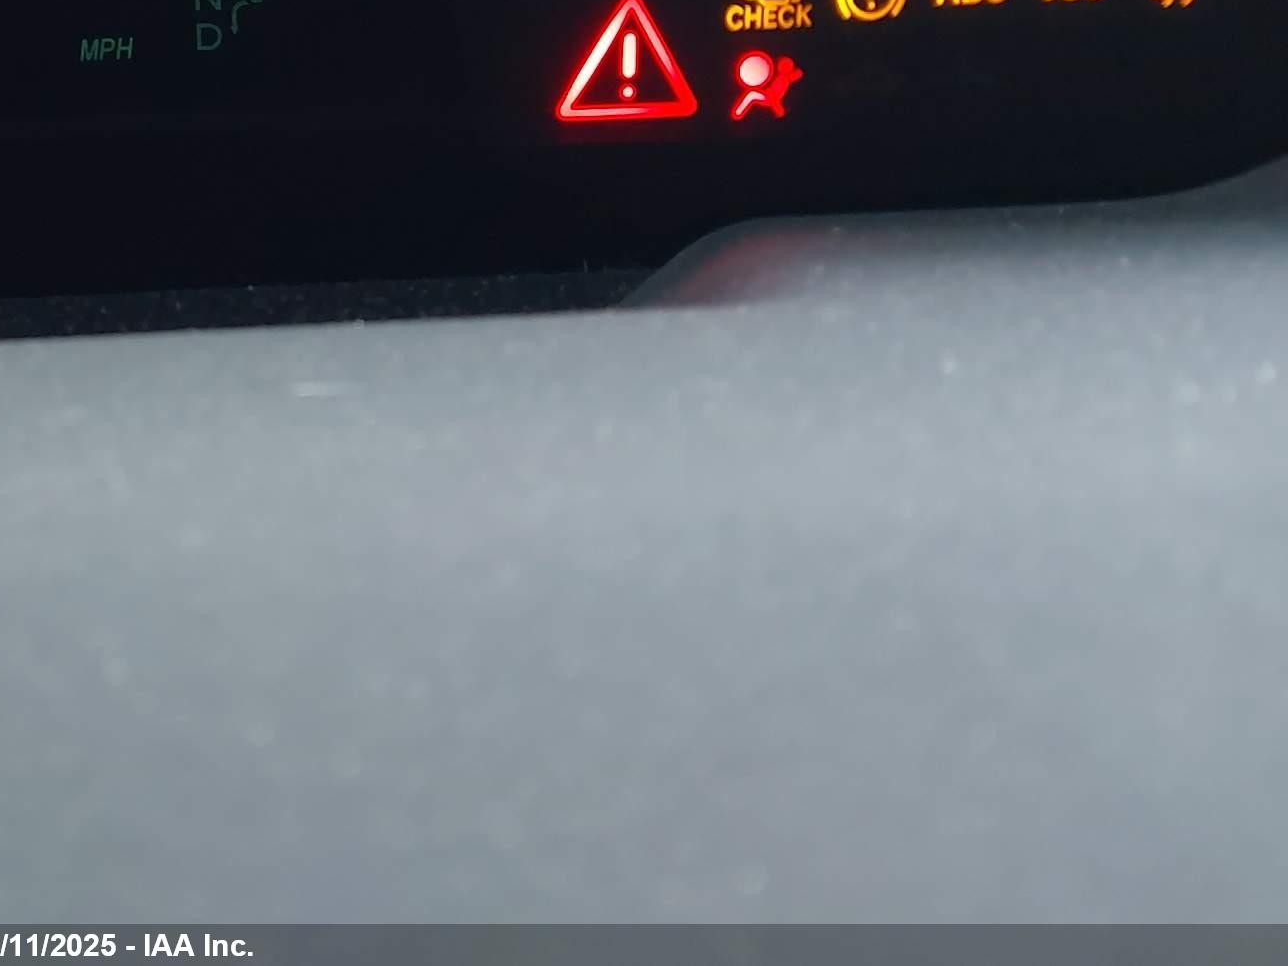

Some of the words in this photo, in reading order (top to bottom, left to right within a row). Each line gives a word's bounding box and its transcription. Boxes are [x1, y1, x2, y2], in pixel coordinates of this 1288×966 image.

[726, 4, 813, 32] CHECK
[79, 37, 134, 62] MPH
[196, 22, 223, 51] D
